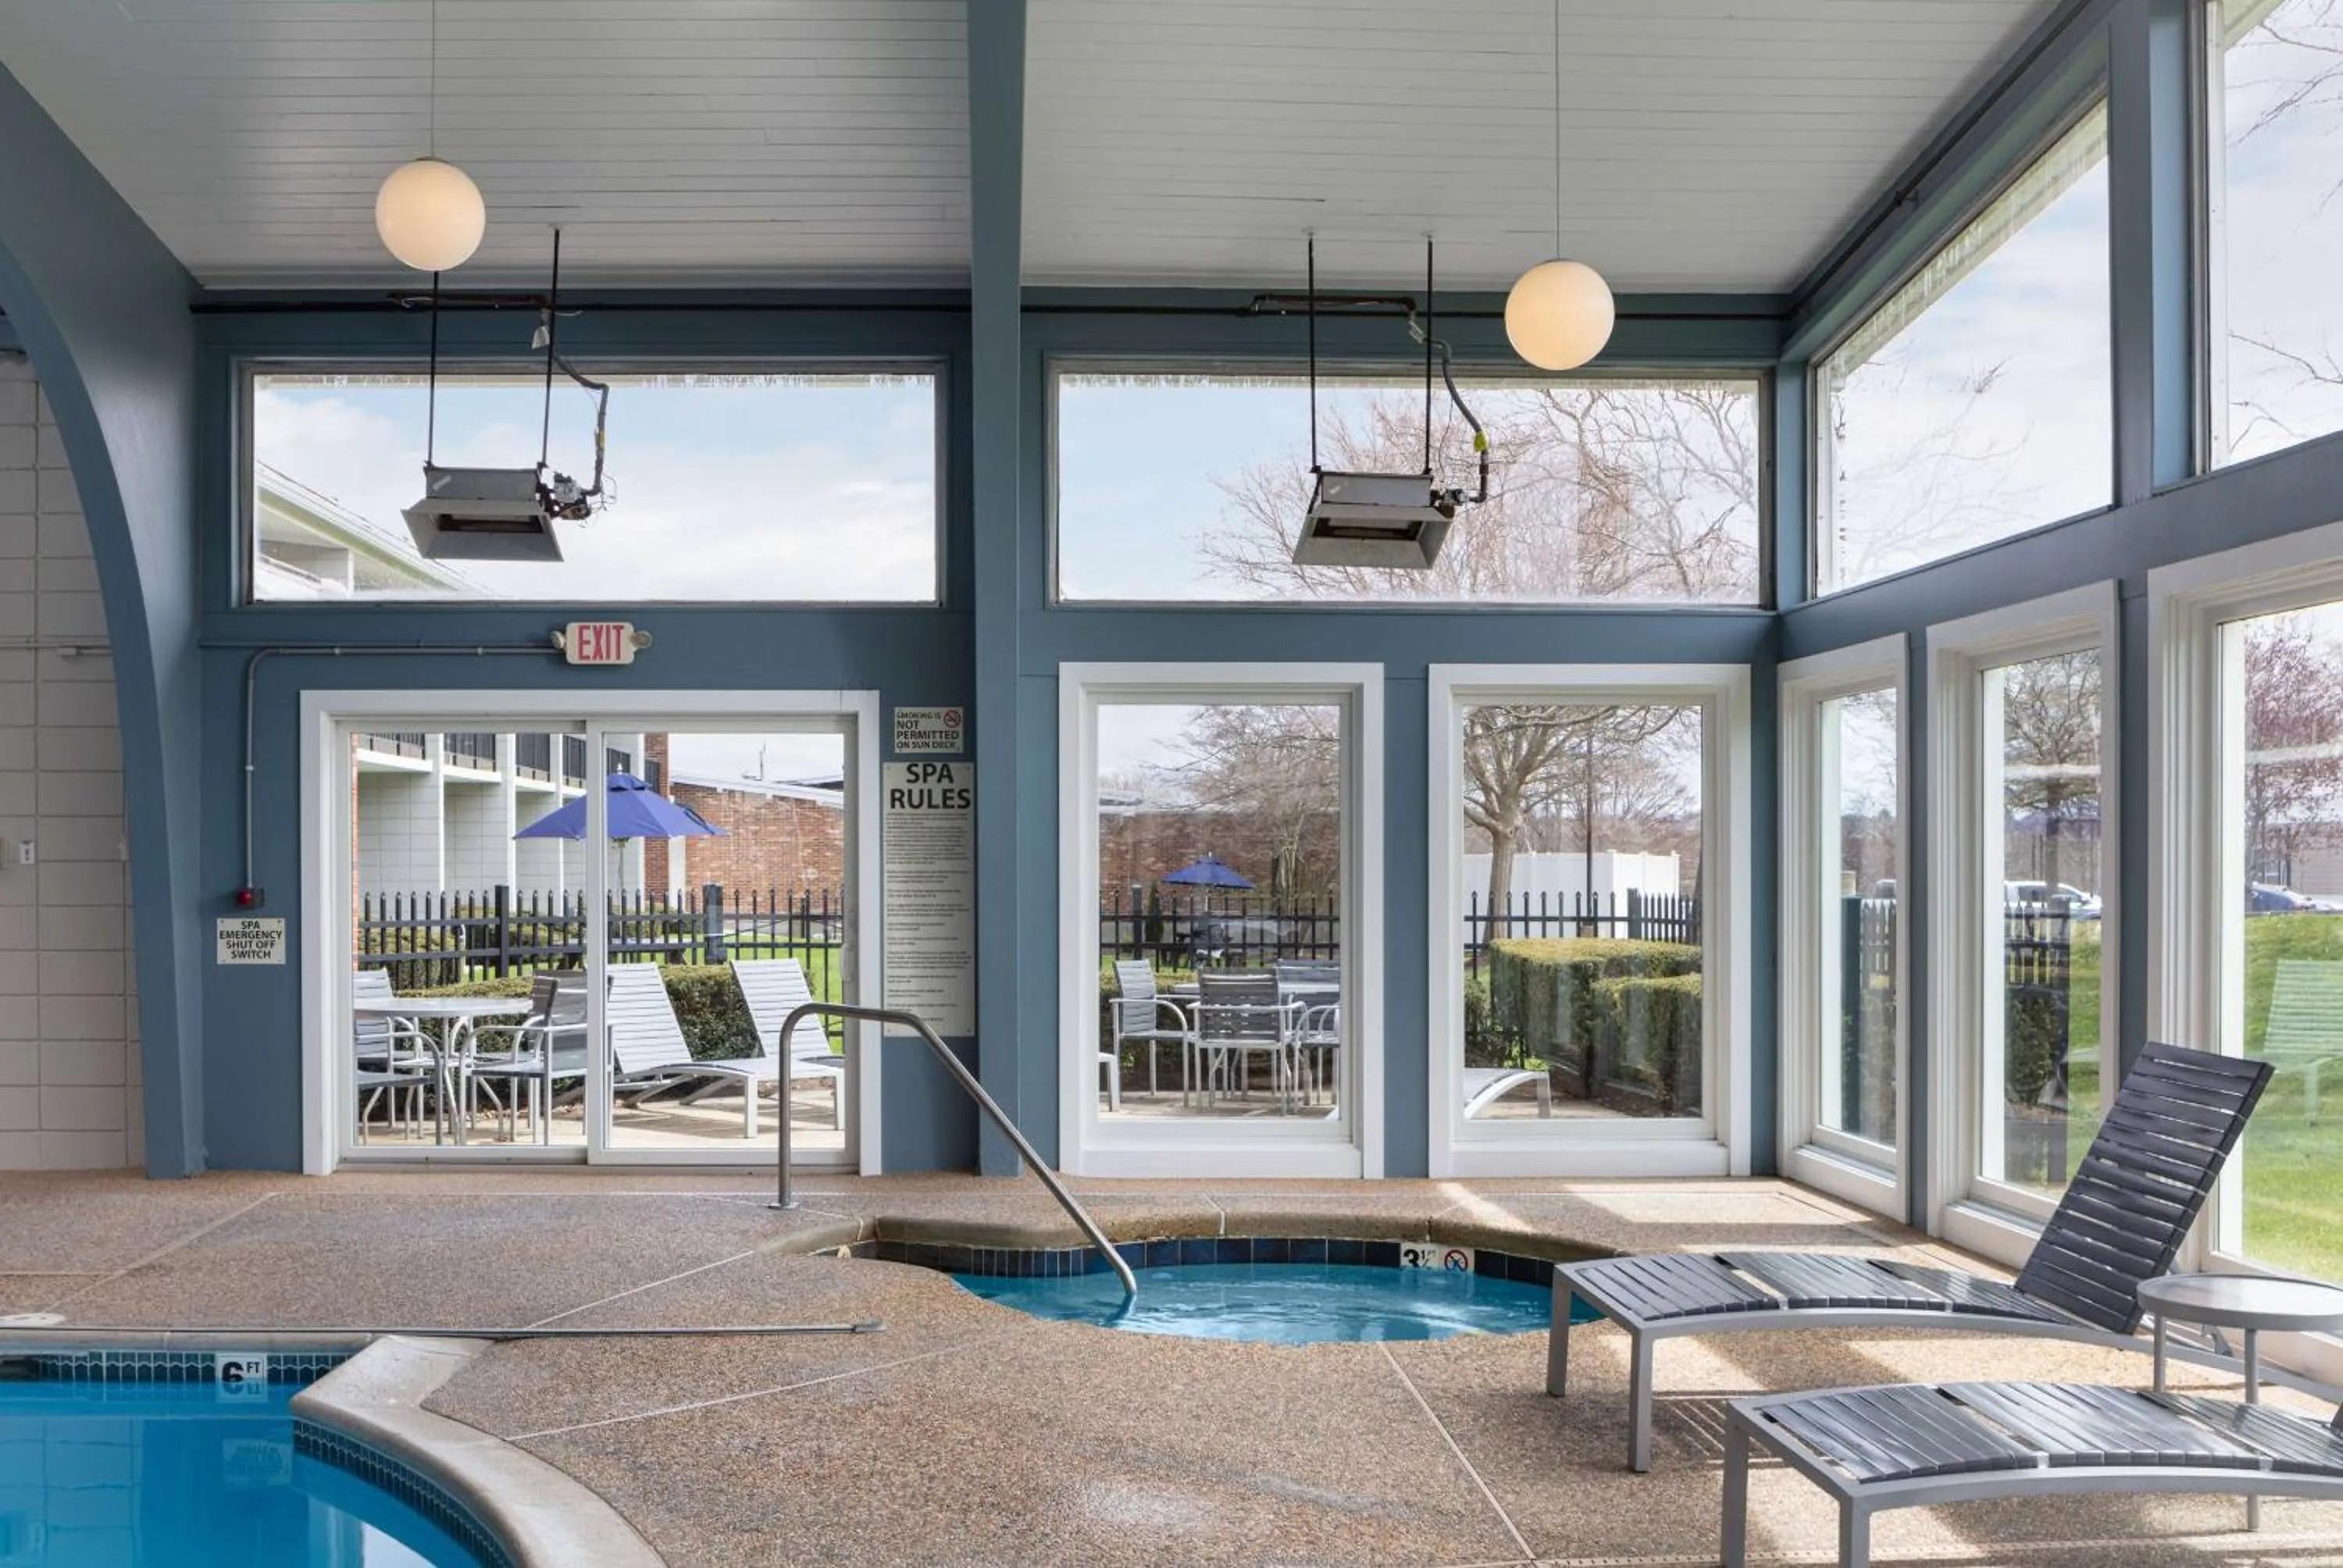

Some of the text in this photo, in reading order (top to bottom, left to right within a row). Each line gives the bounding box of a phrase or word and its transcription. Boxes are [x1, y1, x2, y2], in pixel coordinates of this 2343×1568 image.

[579, 624, 624, 661] EXIT
[897, 720, 919, 730] NOT
[897, 730, 960, 739] PERMITTED
[906, 763, 954, 784] SPA
[890, 788, 972, 810] RULES
[241, 921, 261, 930] SPA
[219, 930, 282, 939] EMERGENCY
[226, 940, 276, 949] SHUT OFF
[231, 950, 271, 959] SWITCH
[222, 1361, 260, 1383] 6 FT
